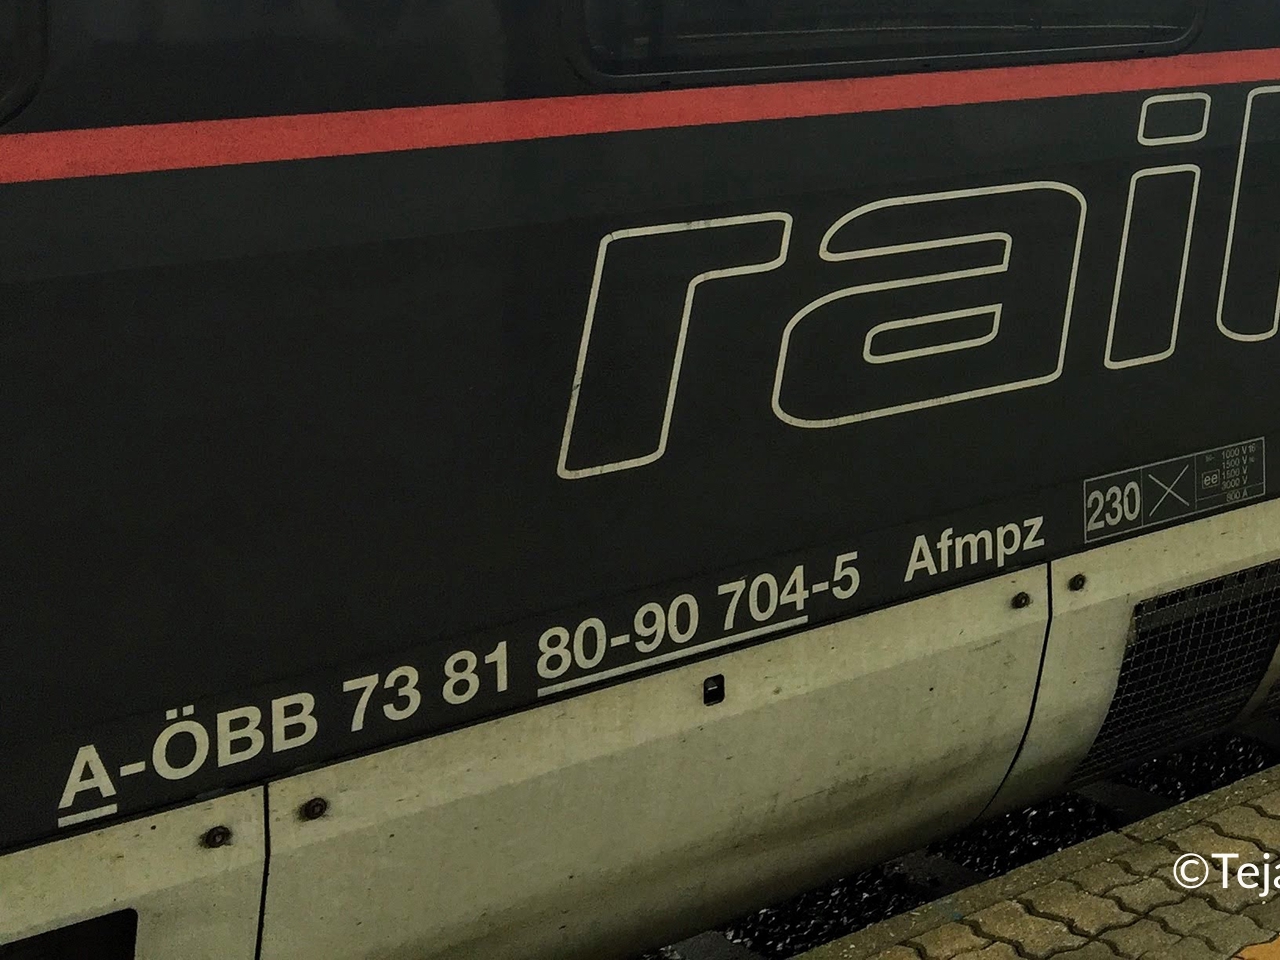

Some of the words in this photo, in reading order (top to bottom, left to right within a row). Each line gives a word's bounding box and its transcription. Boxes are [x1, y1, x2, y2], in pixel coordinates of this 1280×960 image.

[1203, 473, 1218, 486] ee
[1086, 480, 1142, 532] 230
[58, 709, 319, 810] A-ÖBB
[343, 666, 421, 732] 73
[442, 649, 508, 704] 81
[537, 592, 700, 680] 80-90
[717, 551, 861, 624] 704-5
[903, 515, 1045, 583] Afmpz
